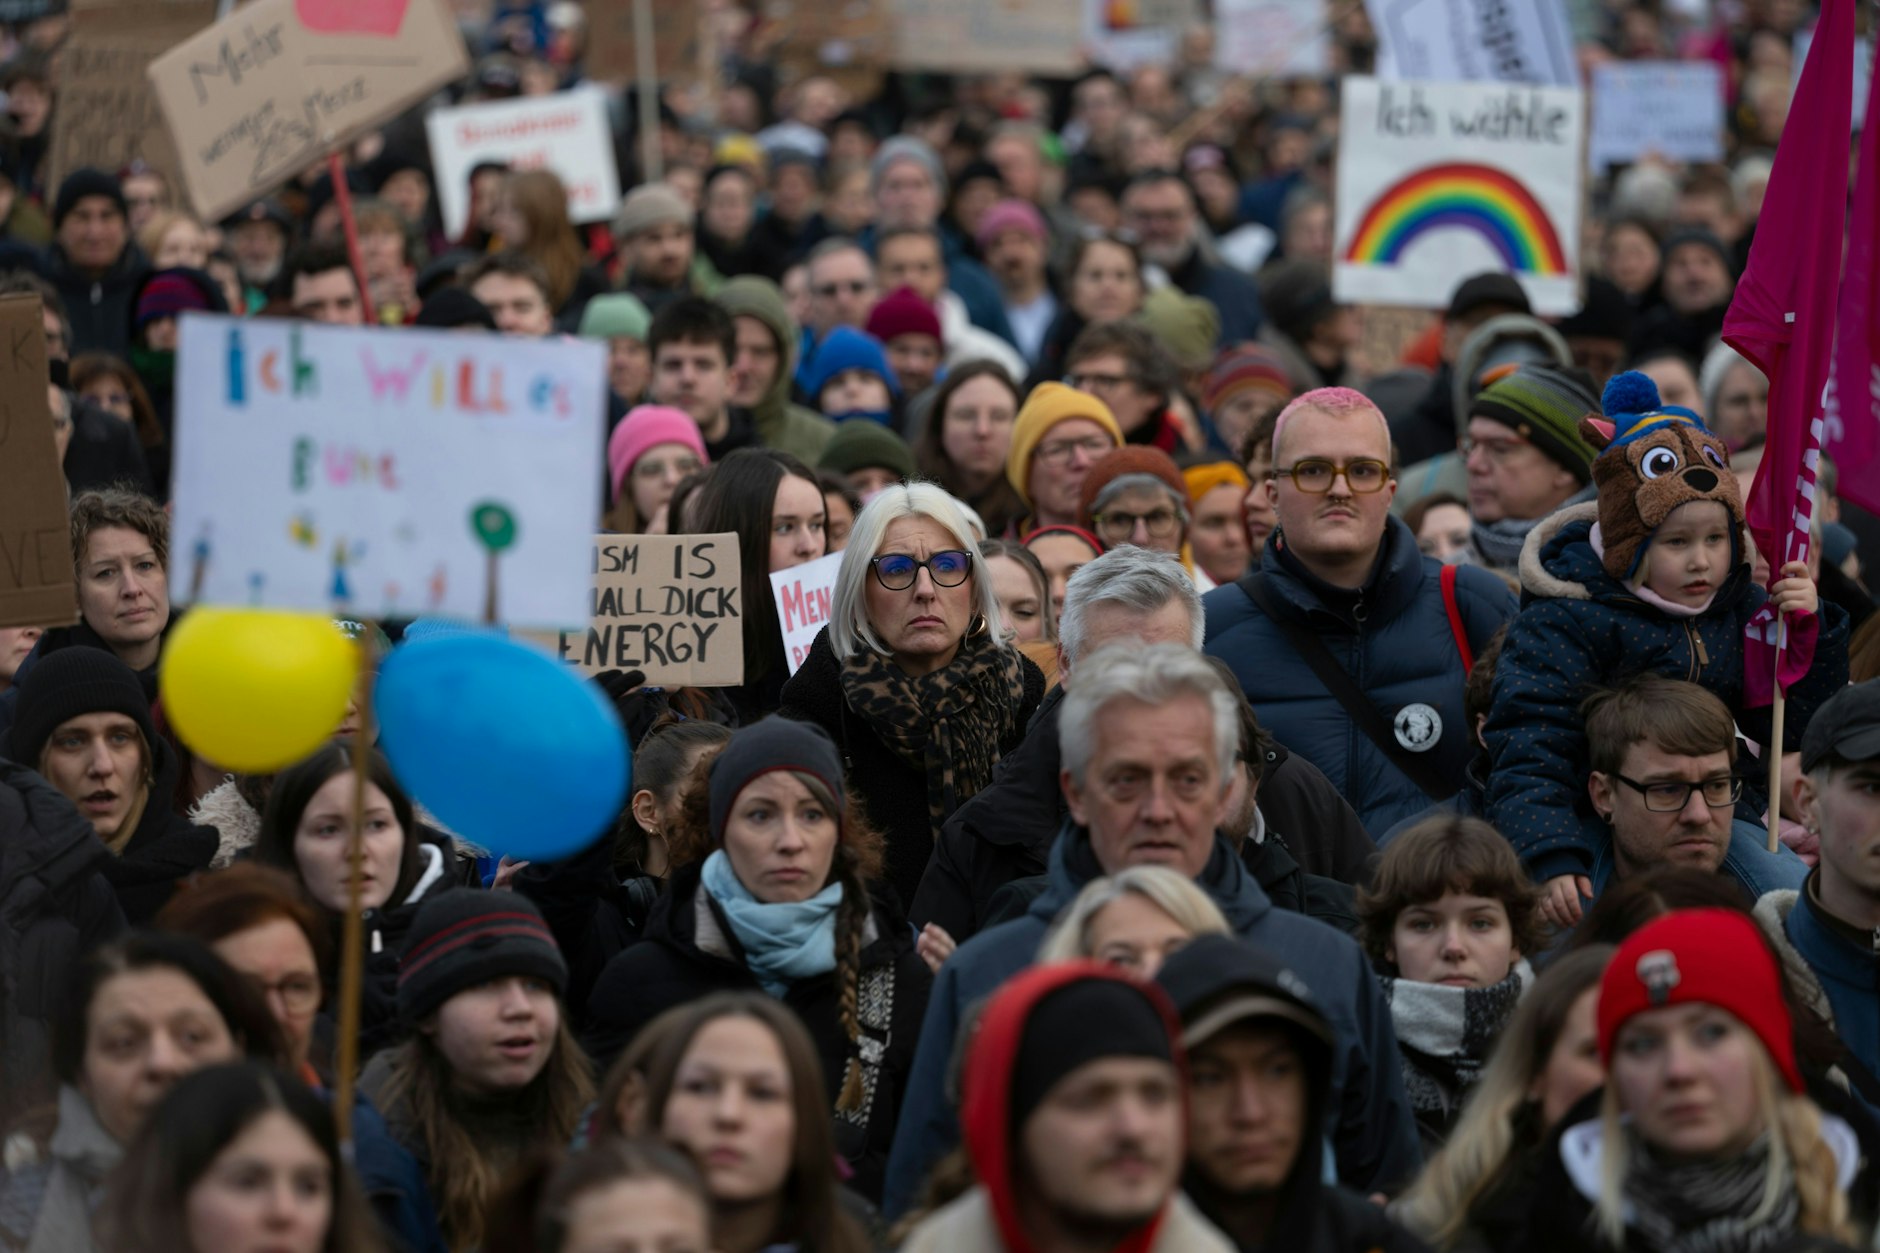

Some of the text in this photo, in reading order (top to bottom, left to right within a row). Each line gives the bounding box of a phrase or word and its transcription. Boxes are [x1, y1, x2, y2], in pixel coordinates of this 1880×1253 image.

[187, 22, 284, 108] Mehr
[1376, 85, 1570, 145] Ich wähle
[225, 325, 319, 407] Ich
[674, 543, 716, 579] IS
[659, 585, 740, 619] DICK
[558, 622, 719, 667] ENERGY
